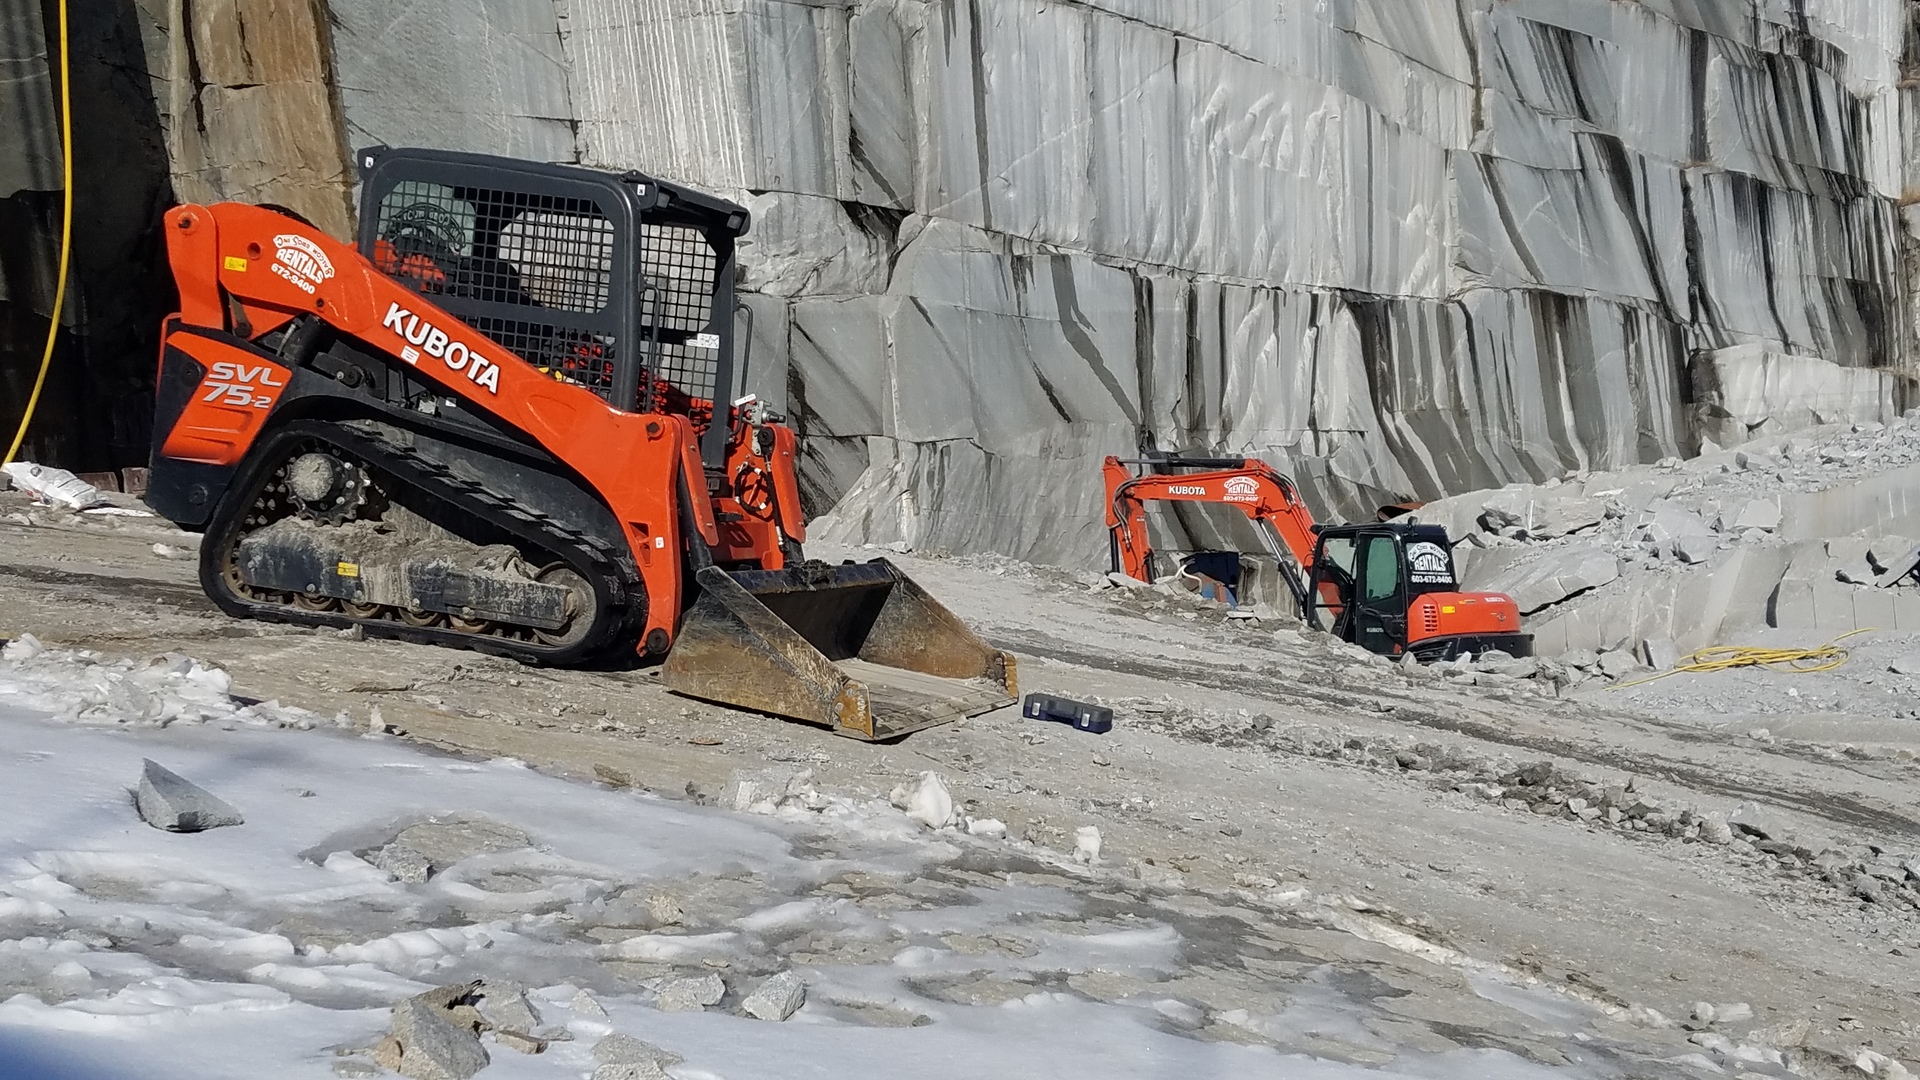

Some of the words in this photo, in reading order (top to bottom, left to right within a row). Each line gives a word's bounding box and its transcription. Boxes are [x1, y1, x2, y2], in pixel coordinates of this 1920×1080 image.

[271, 263, 316, 295] 672-9400
[276, 248, 324, 284] RENTALS
[382, 301, 500, 395] KUBOTA
[208, 361, 282, 387] SVL
[202, 381, 272, 409] 75-2
[1168, 485, 1206, 496] KUBOTA
[1228, 483, 1256, 494] RENTALS
[1414, 554, 1447, 571] RENTALS
[1411, 575, 1453, 584] 603-672-9400
